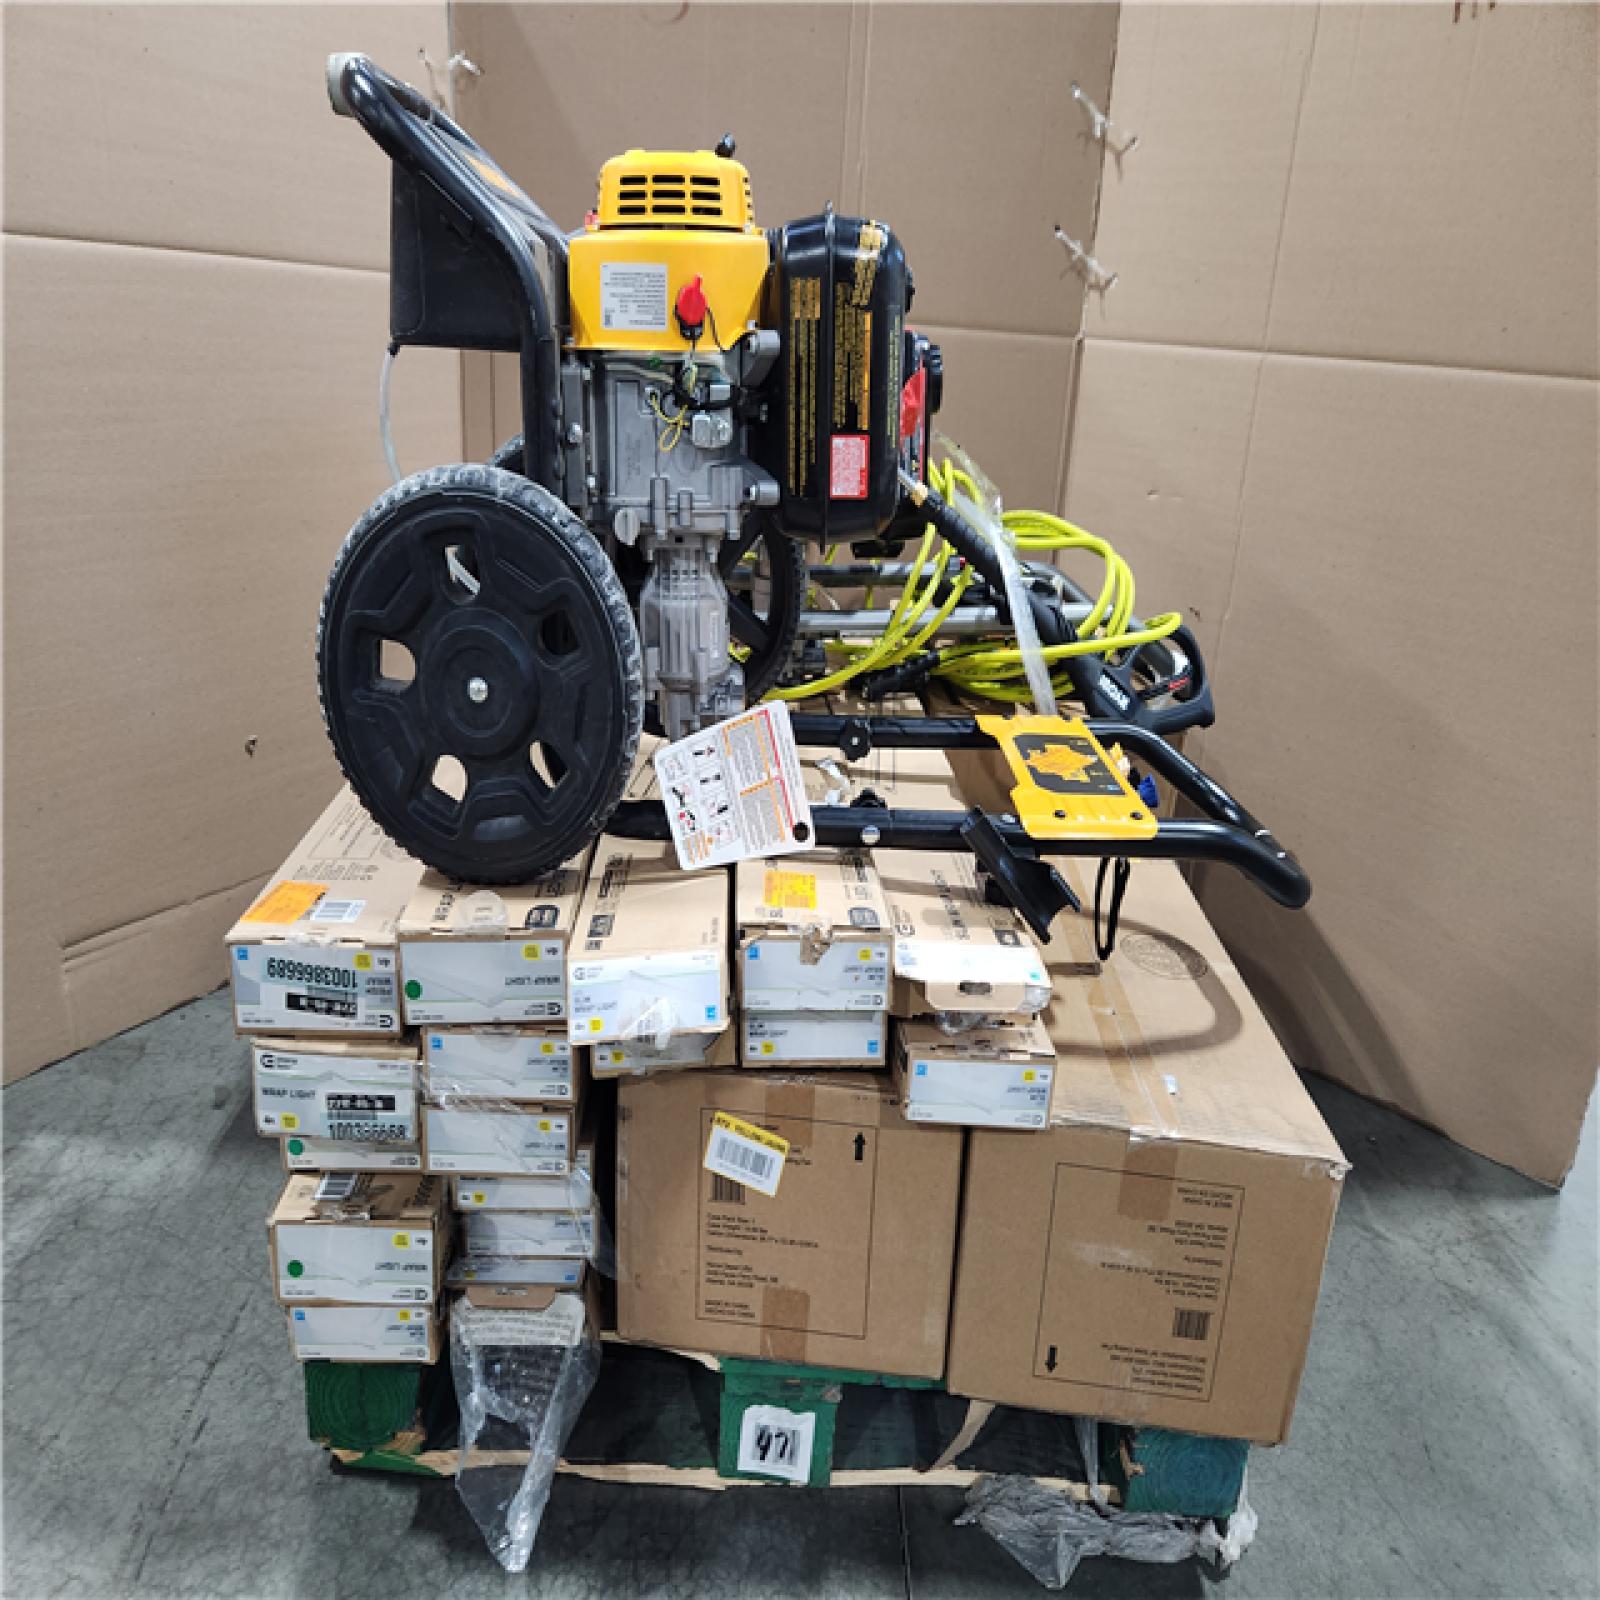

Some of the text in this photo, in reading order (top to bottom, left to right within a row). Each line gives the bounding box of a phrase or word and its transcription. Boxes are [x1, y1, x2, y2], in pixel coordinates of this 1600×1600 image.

[504, 975, 561, 987] WRAP LIGHT
[262, 1087, 316, 1099] WRAP LIGHT
[374, 1261, 428, 1272] WRAP LIGHT
